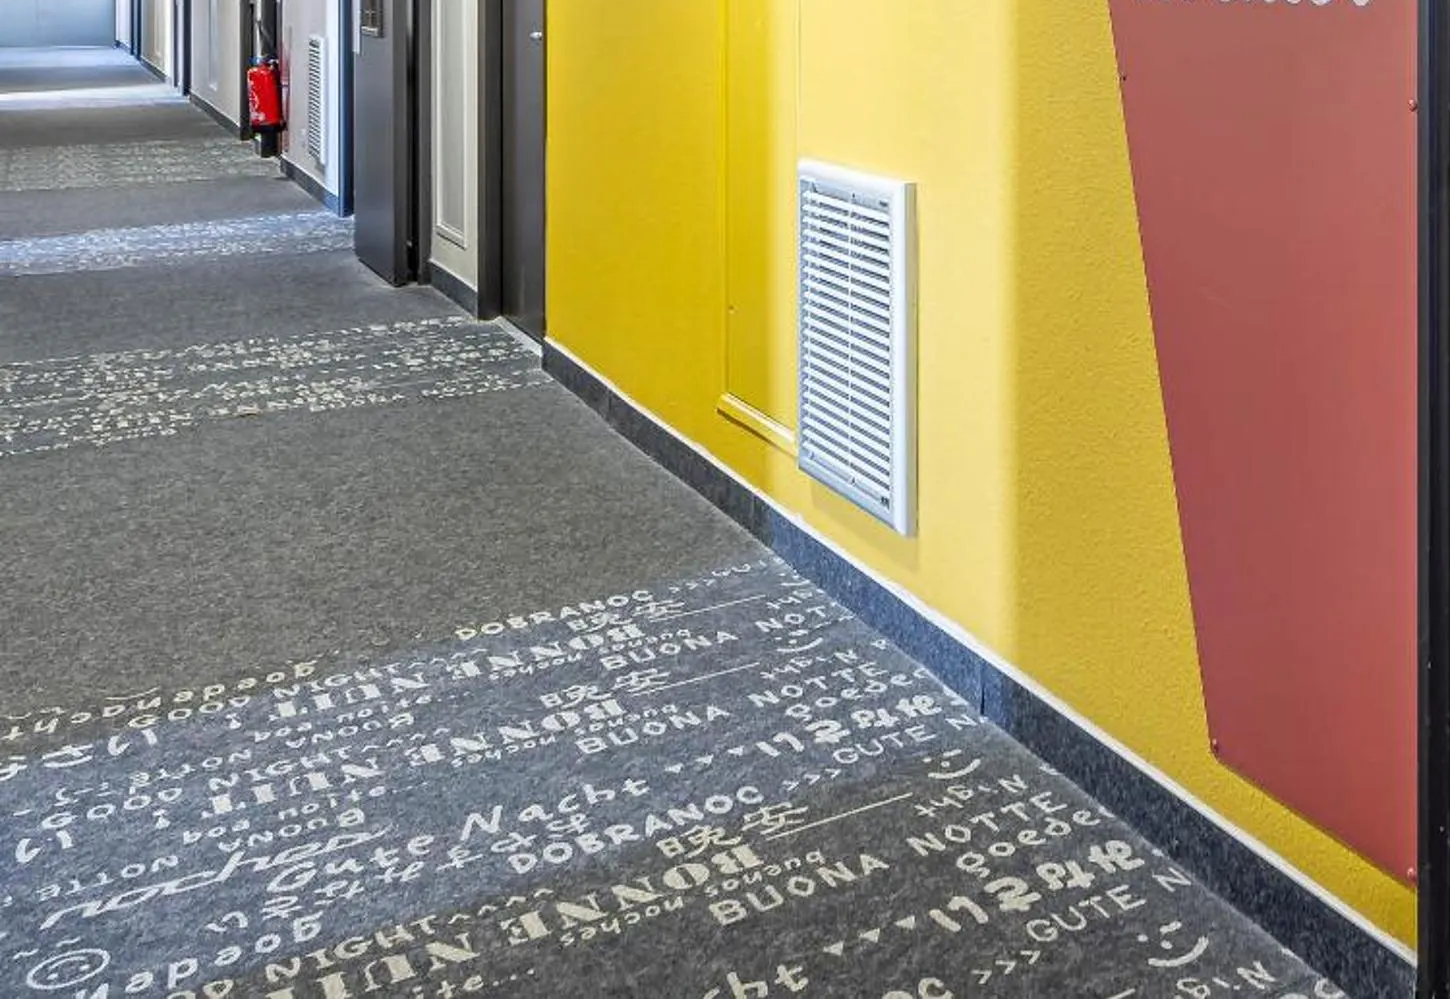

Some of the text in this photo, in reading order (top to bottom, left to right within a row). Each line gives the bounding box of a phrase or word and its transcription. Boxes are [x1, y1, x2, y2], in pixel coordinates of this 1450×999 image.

[455, 591, 653, 640] DOBRANOC
[600, 630, 738, 670] BUONA
[574, 661, 889, 756] BUONA NOTTE
[832, 724, 936, 764] GUTE
[265, 778, 649, 893] Gute Nacht
[507, 785, 765, 874] DOBRANOC
[708, 791, 1068, 926] BUONA NOTTE
[265, 913, 440, 983] NIGHT
[1025, 884, 1147, 943] GUTE
